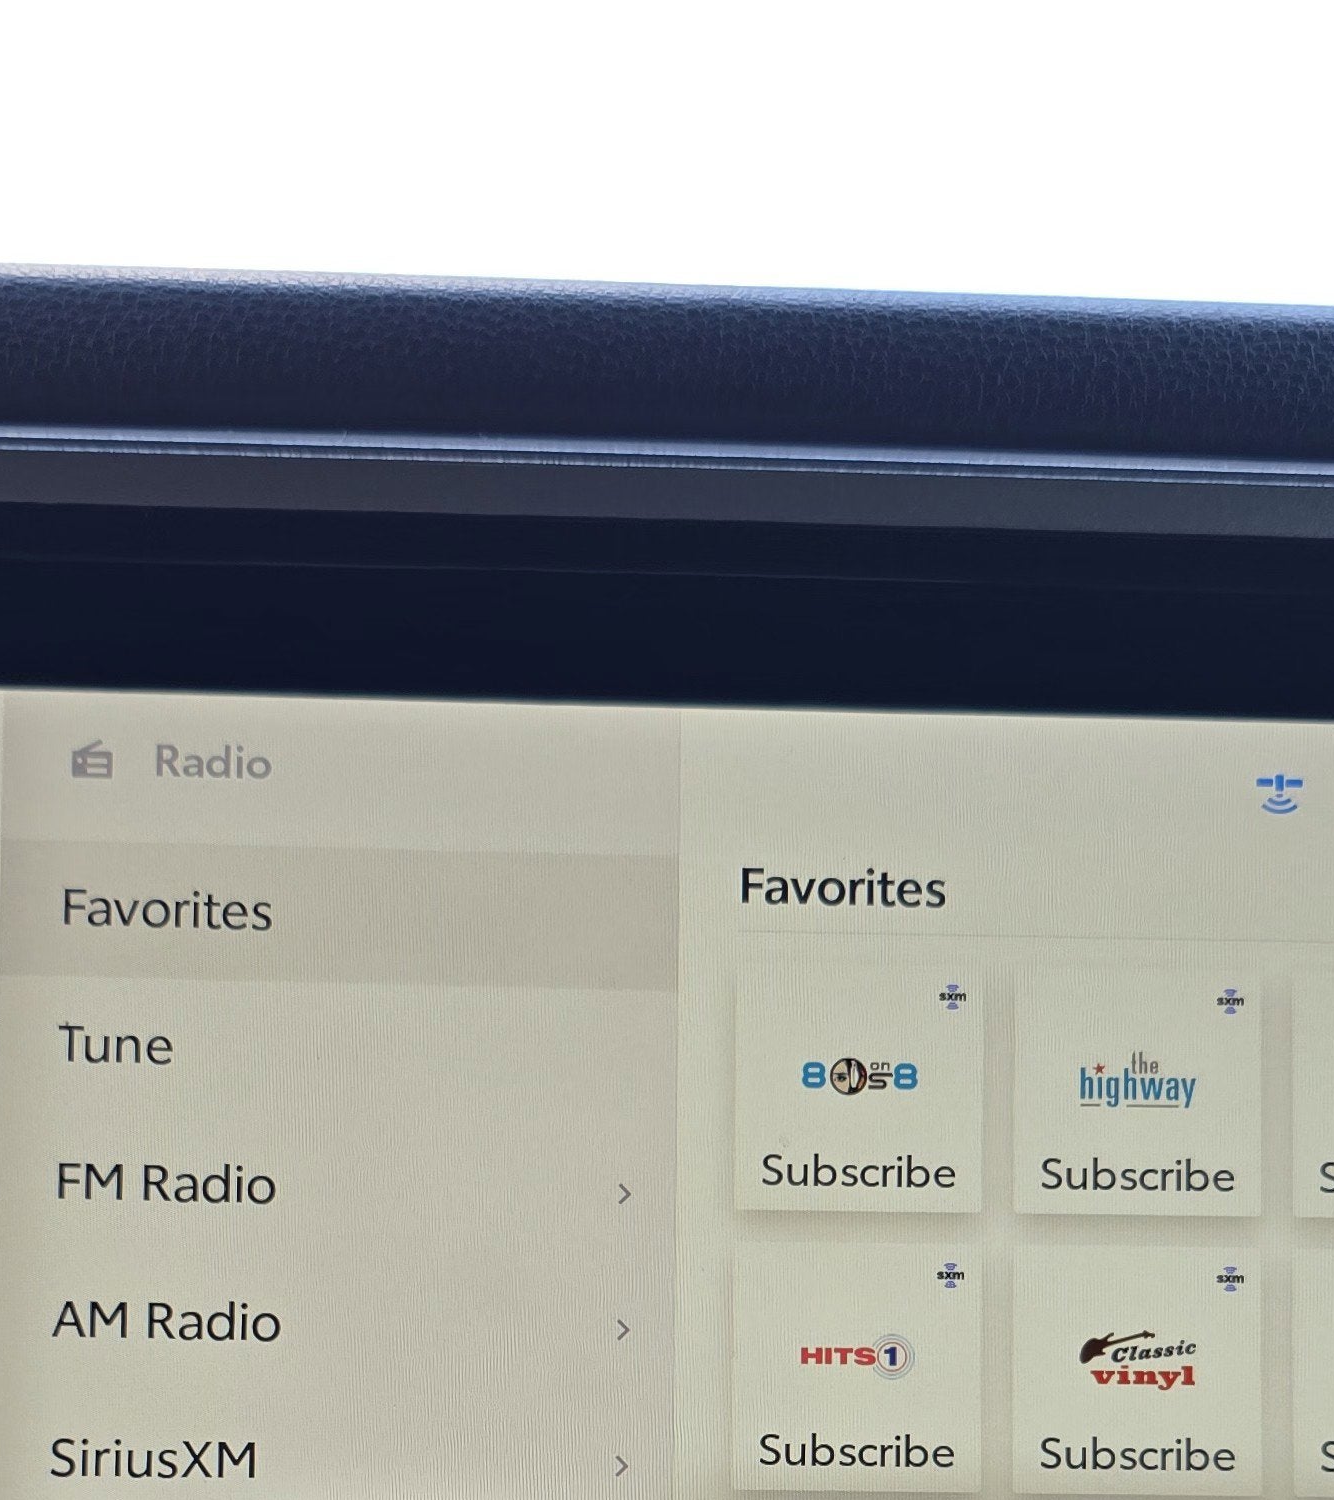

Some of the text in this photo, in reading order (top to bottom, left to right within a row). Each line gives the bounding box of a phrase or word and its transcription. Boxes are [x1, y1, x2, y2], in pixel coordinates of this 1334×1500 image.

[155, 743, 273, 780] Radio
[741, 867, 946, 908] Favorites
[63, 888, 273, 931] Favorites
[58, 1022, 174, 1066] Tune
[1131, 1050, 1159, 1074] the
[1079, 1064, 1197, 1109] highway
[57, 1162, 276, 1205] FM Radio
[761, 1152, 956, 1189] Subscribe
[1041, 1156, 1235, 1193] Subscribe
[51, 1300, 281, 1343] AM Radio
[800, 1347, 877, 1366] HITS
[1110, 1340, 1197, 1363] Classic
[1090, 1365, 1196, 1391] vinyl
[50, 1437, 256, 1479] SiriusXM
[759, 1432, 955, 1468] Subscribe
[1040, 1435, 1236, 1472] Subscribe
